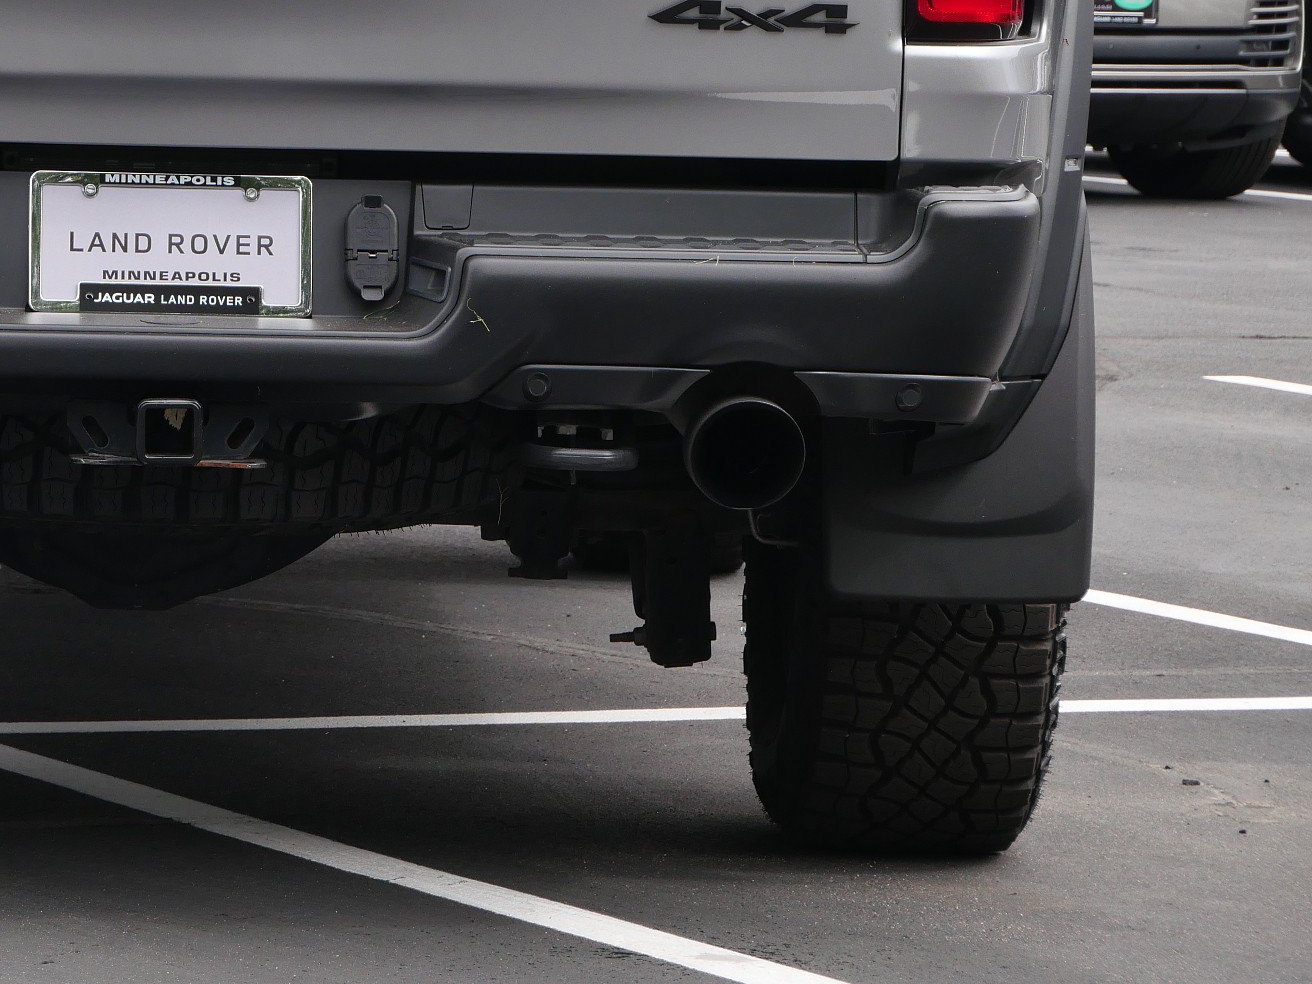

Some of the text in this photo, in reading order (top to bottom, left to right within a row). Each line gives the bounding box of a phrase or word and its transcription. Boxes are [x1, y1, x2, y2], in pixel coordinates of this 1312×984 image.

[647, 0, 860, 34] 4x4
[104, 173, 235, 186] MINNEAPOLIS
[69, 231, 274, 256] LAND ROVER
[102, 269, 241, 282] MINNEAPOLIS
[93, 292, 243, 306] JAGUAR LAND ROVER
